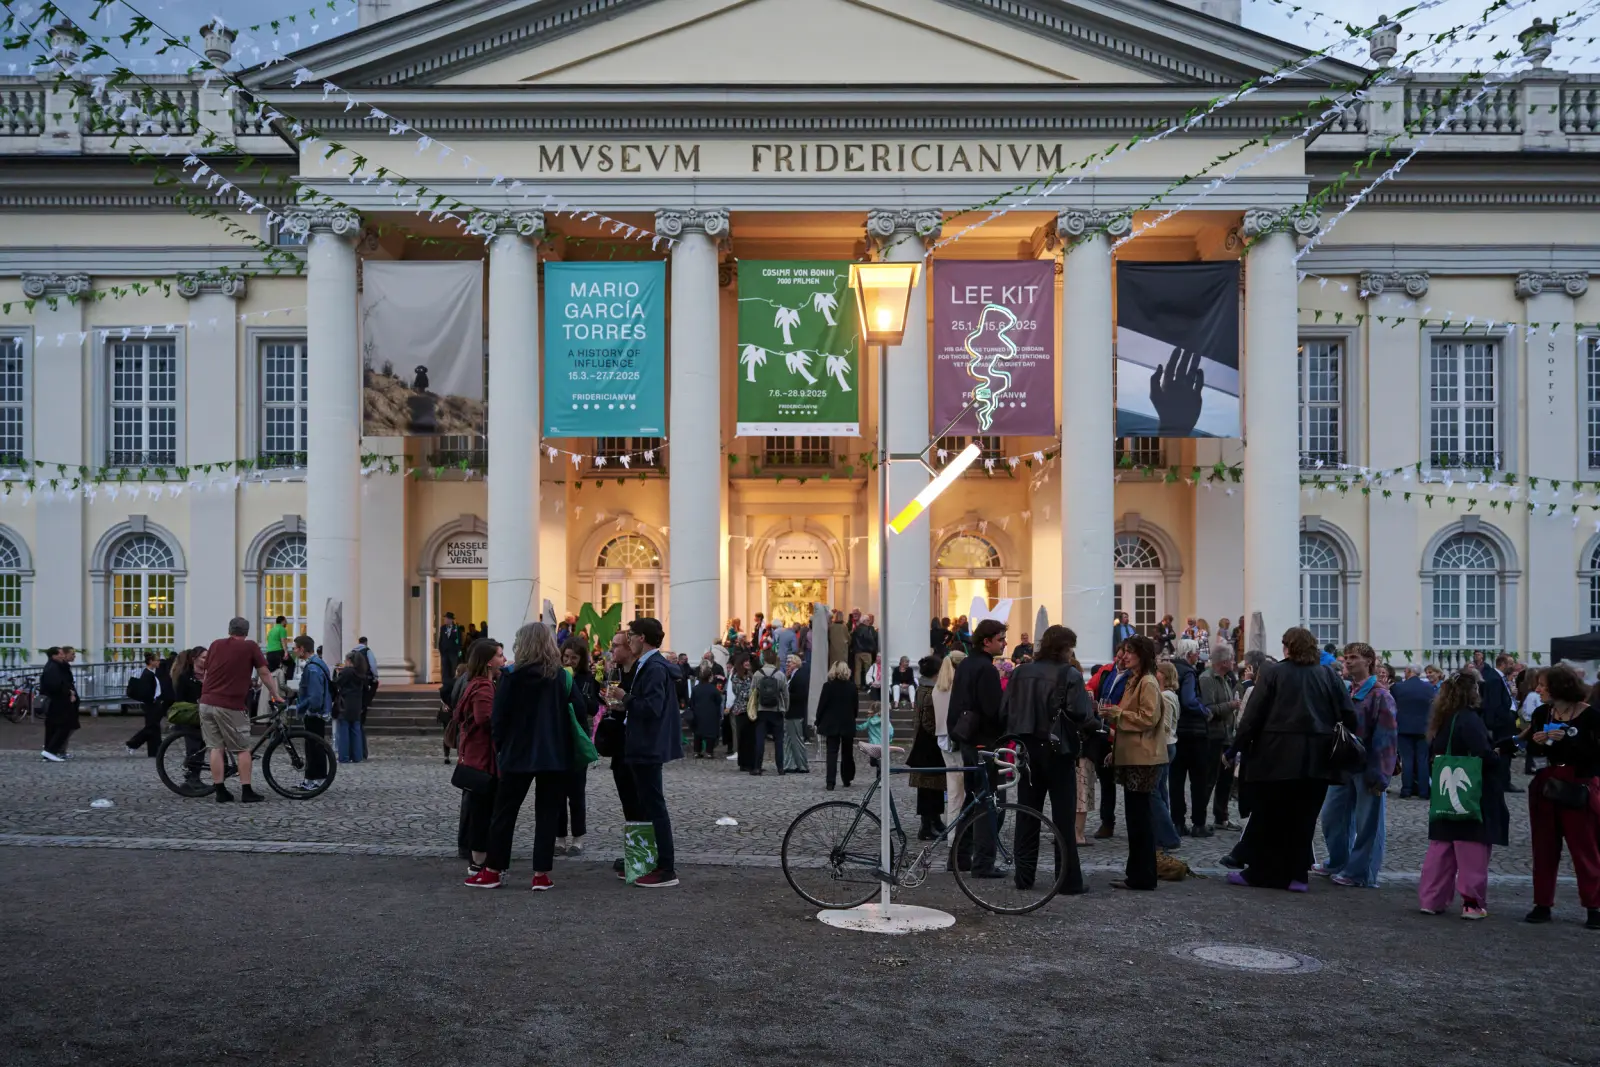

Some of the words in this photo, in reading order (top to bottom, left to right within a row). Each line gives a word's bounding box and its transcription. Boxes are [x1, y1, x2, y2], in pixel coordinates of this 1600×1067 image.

[538, 144, 700, 173] MVSEVM
[751, 144, 1064, 173] FRIDERICIANVM
[762, 269, 790, 277] COSIMA
[793, 269, 808, 277] VON
[810, 269, 835, 277] BONIN
[570, 282, 639, 297] MARIO
[951, 286, 993, 304] LEE
[1002, 286, 1038, 304] KIT
[564, 300, 645, 319] GARCÍA
[562, 324, 646, 340] TORRES
[568, 350, 574, 358] A
[577, 349, 623, 358] HISTORY
[626, 350, 641, 358] OF
[574, 359, 634, 368] INFLUENCE
[572, 393, 636, 401] FRIDERICIANVM
[447, 542, 488, 550] KASSELE
[447, 549, 477, 557] KUNST
